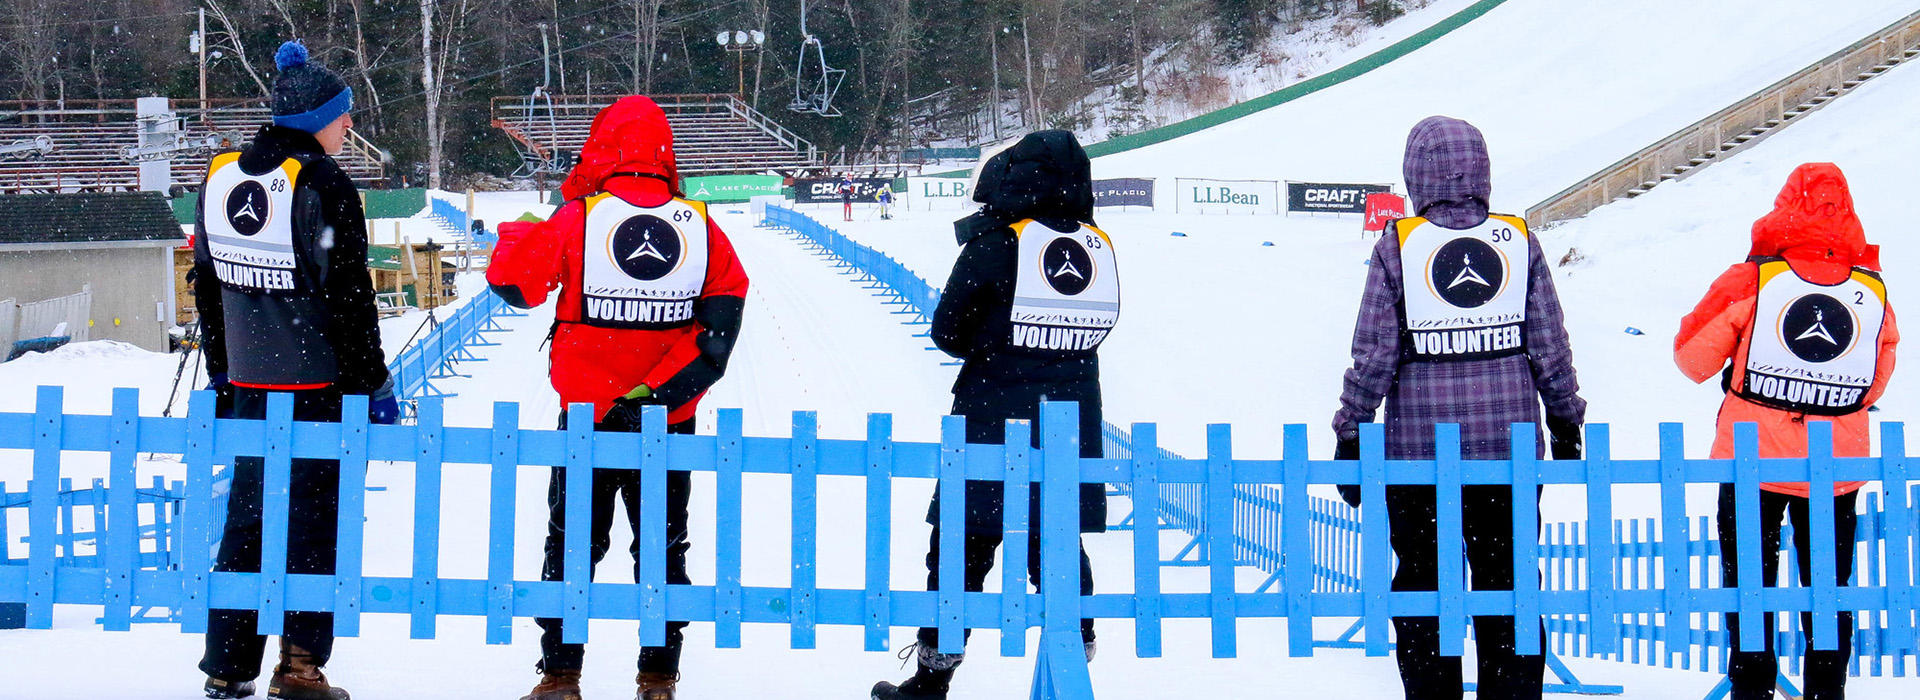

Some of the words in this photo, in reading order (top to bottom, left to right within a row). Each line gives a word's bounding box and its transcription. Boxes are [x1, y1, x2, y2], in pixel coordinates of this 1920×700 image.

[269, 178, 286, 193] 88
[811, 182, 862, 195] CRAT
[1193, 186, 1259, 205] L.L.Bean
[1305, 188, 1359, 203] CRAFT
[672, 209, 693, 222] 69
[1085, 234, 1102, 249] 85
[1492, 227, 1512, 243] 50
[213, 259, 295, 290] VOLUNTEER
[1854, 290, 1864, 305] 2
[587, 297, 694, 323] VOLUNTEER
[1013, 324, 1108, 351] VOLUNTEER
[1412, 325, 1521, 355] VOLUNTEER
[1749, 372, 1863, 407] VOLUNTEER
